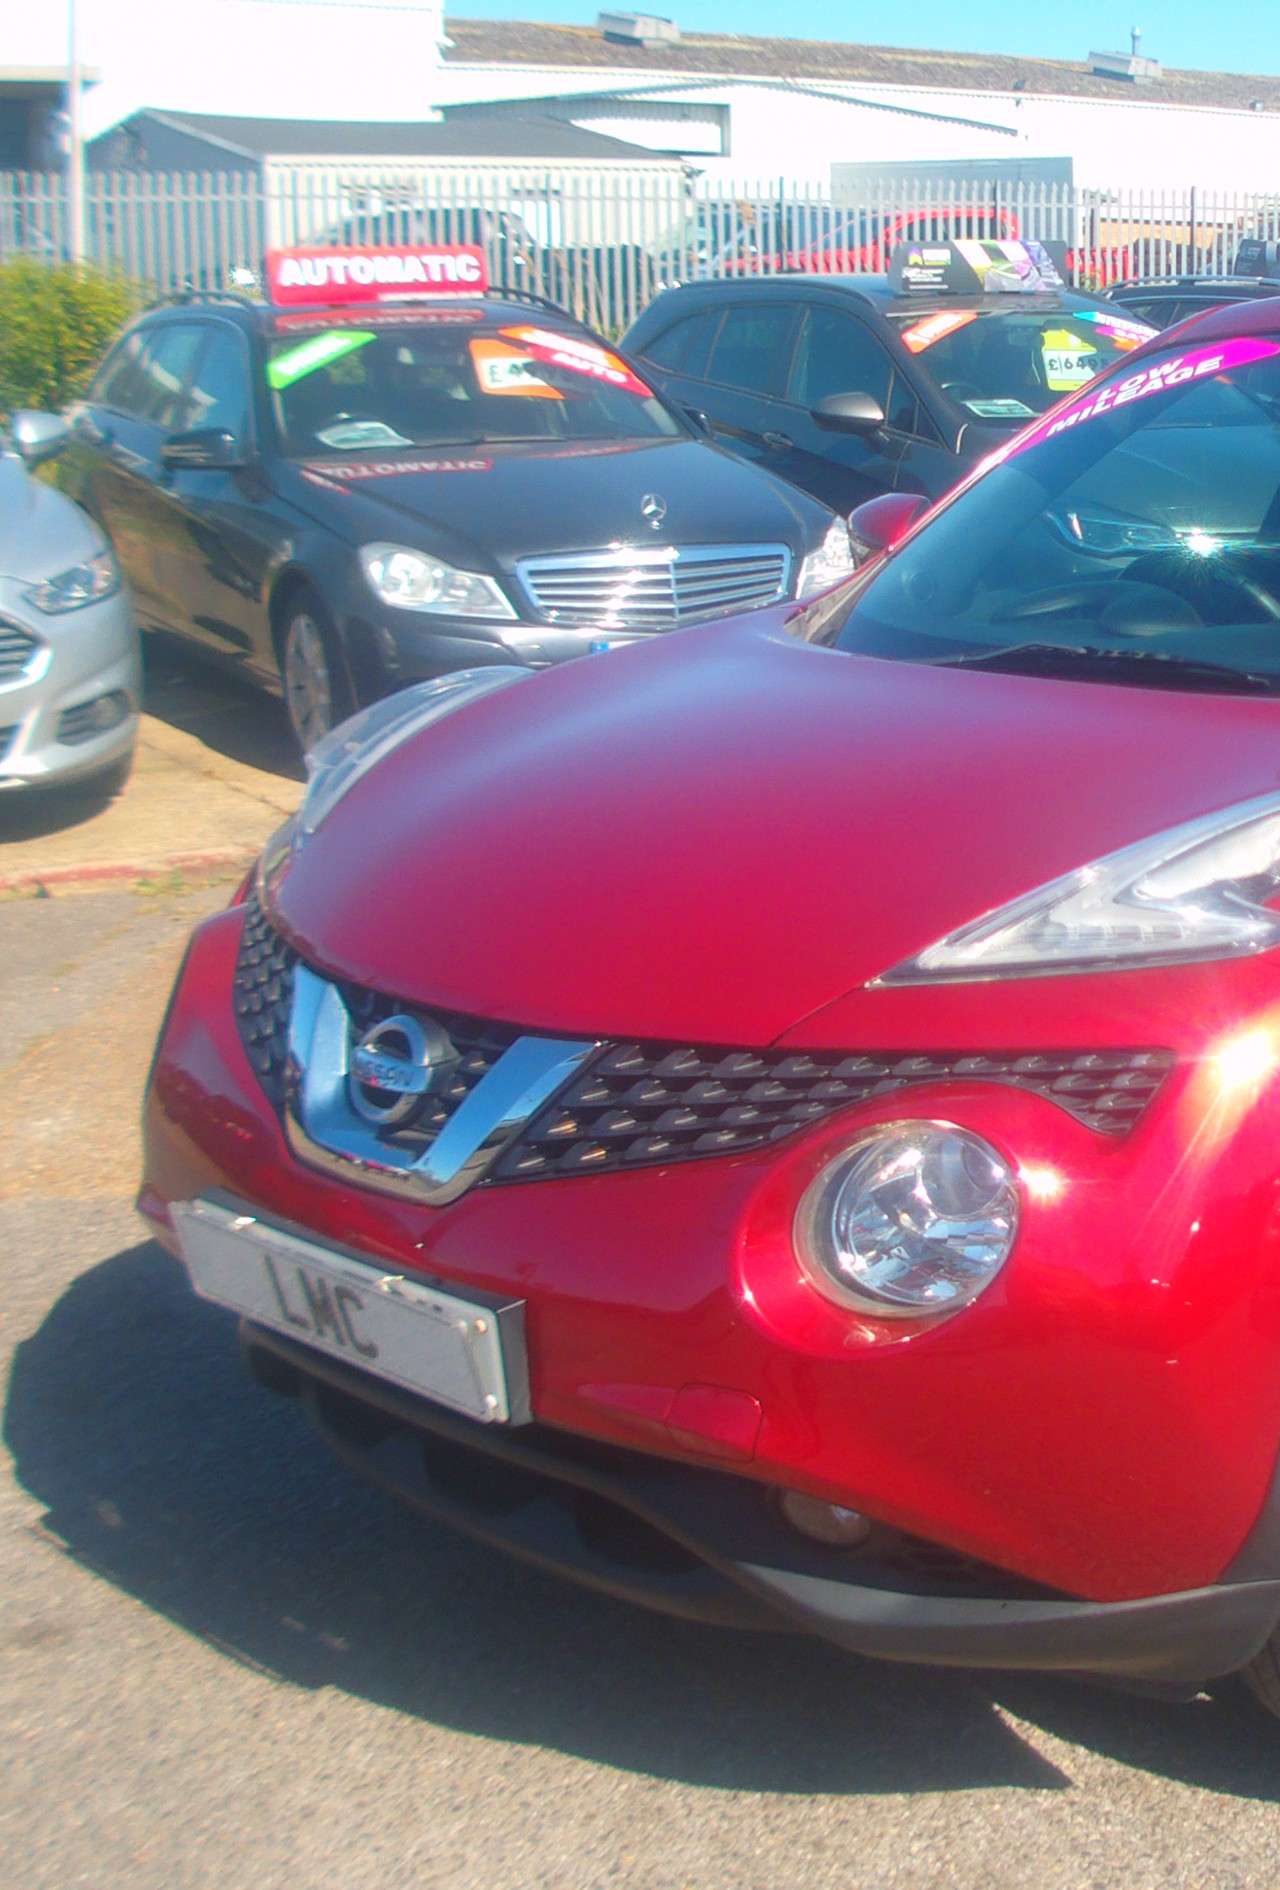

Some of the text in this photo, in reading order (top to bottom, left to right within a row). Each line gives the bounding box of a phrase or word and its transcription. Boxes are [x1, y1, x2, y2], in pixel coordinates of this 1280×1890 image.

[279, 254, 481, 287] AUTOMATIC
[1045, 354, 1225, 438] MILEAGE
[1099, 357, 1184, 402] LOW
[264, 1253, 380, 1358] LMC
